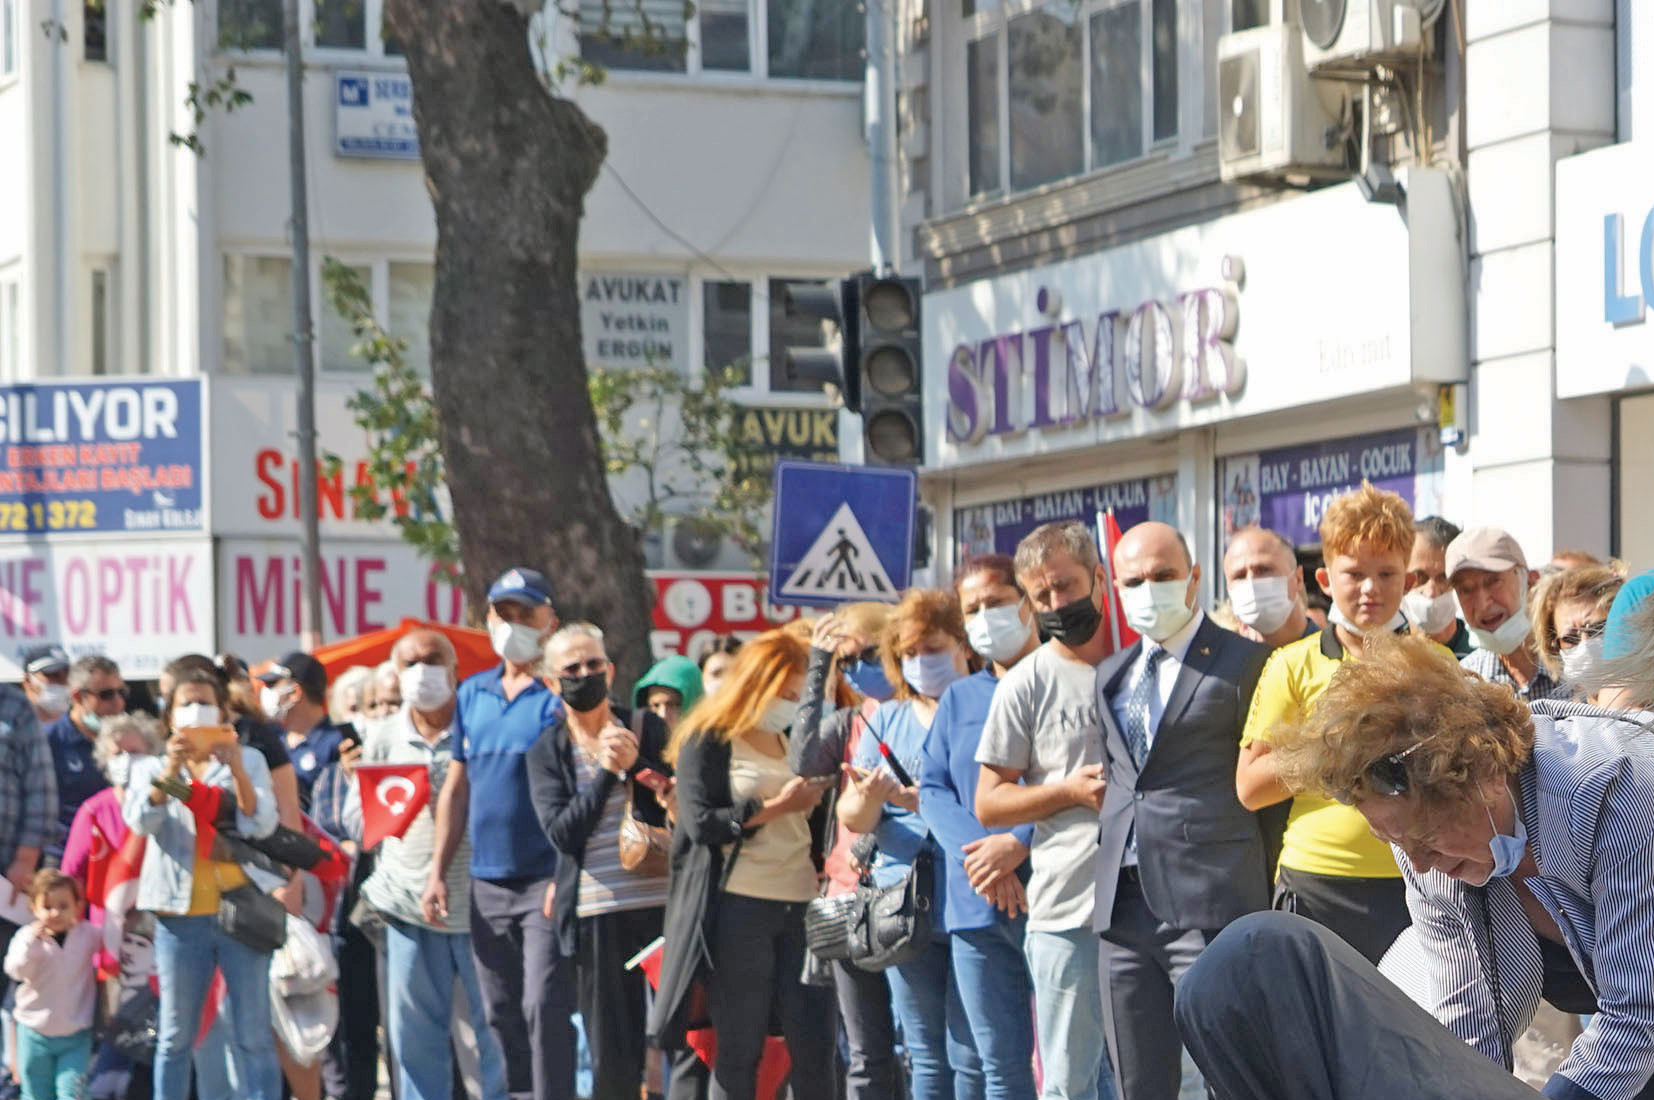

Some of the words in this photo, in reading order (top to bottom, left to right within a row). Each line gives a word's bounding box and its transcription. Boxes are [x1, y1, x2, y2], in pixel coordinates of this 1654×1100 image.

[586, 276, 682, 304] AVUKAT
[600, 311, 670, 333] Yetkin
[0, 386, 178, 444] ILIYOR
[743, 410, 838, 446] AVUK
[1261, 462, 1291, 494] BAY
[1300, 453, 1350, 487] BAYAN
[1360, 443, 1411, 477] ÇOCUK
